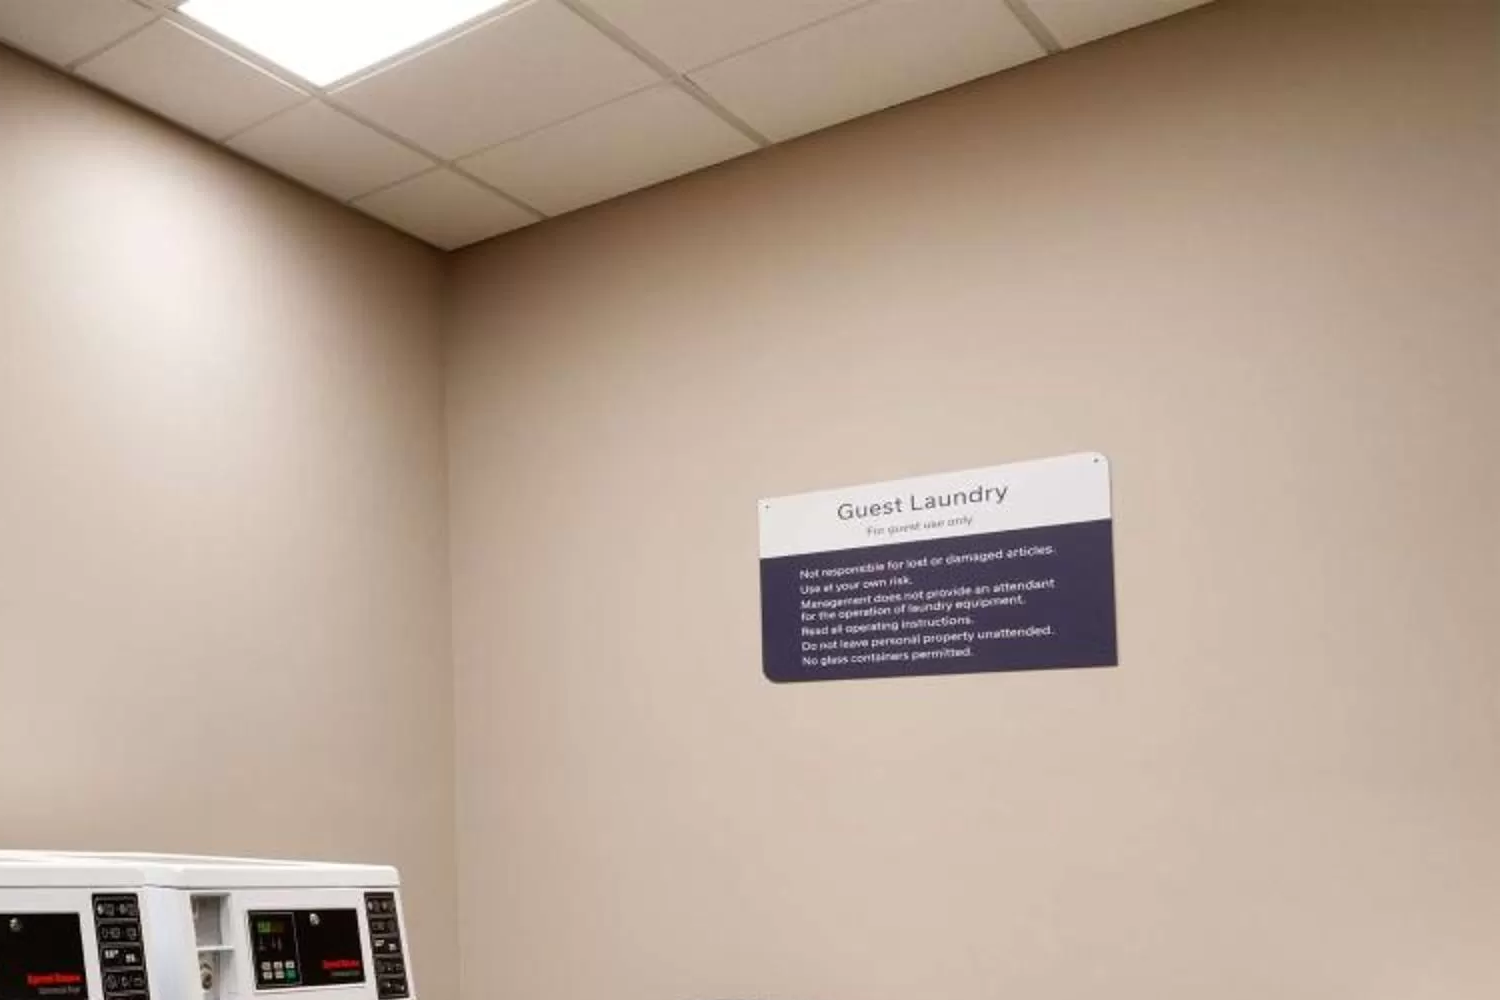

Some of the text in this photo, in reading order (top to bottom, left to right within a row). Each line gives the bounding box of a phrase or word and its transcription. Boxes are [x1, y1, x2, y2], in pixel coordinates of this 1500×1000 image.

[837, 485, 1008, 521] Guest Laundry
[887, 522, 920, 536] guest
[948, 515, 972, 526] only
[800, 545, 1056, 580] Not responsible for lost or damaged articles.
[800, 575, 913, 595] Use at your own risk.
[801, 578, 1055, 609] Management does not provide an attendant
[801, 594, 1026, 622] for the operation of laundry equipment.
[801, 615, 974, 637] Read all operating instructions.
[802, 624, 1054, 652] Do not leave personal property unattended.
[802, 646, 974, 667] No glass containers permitted.
